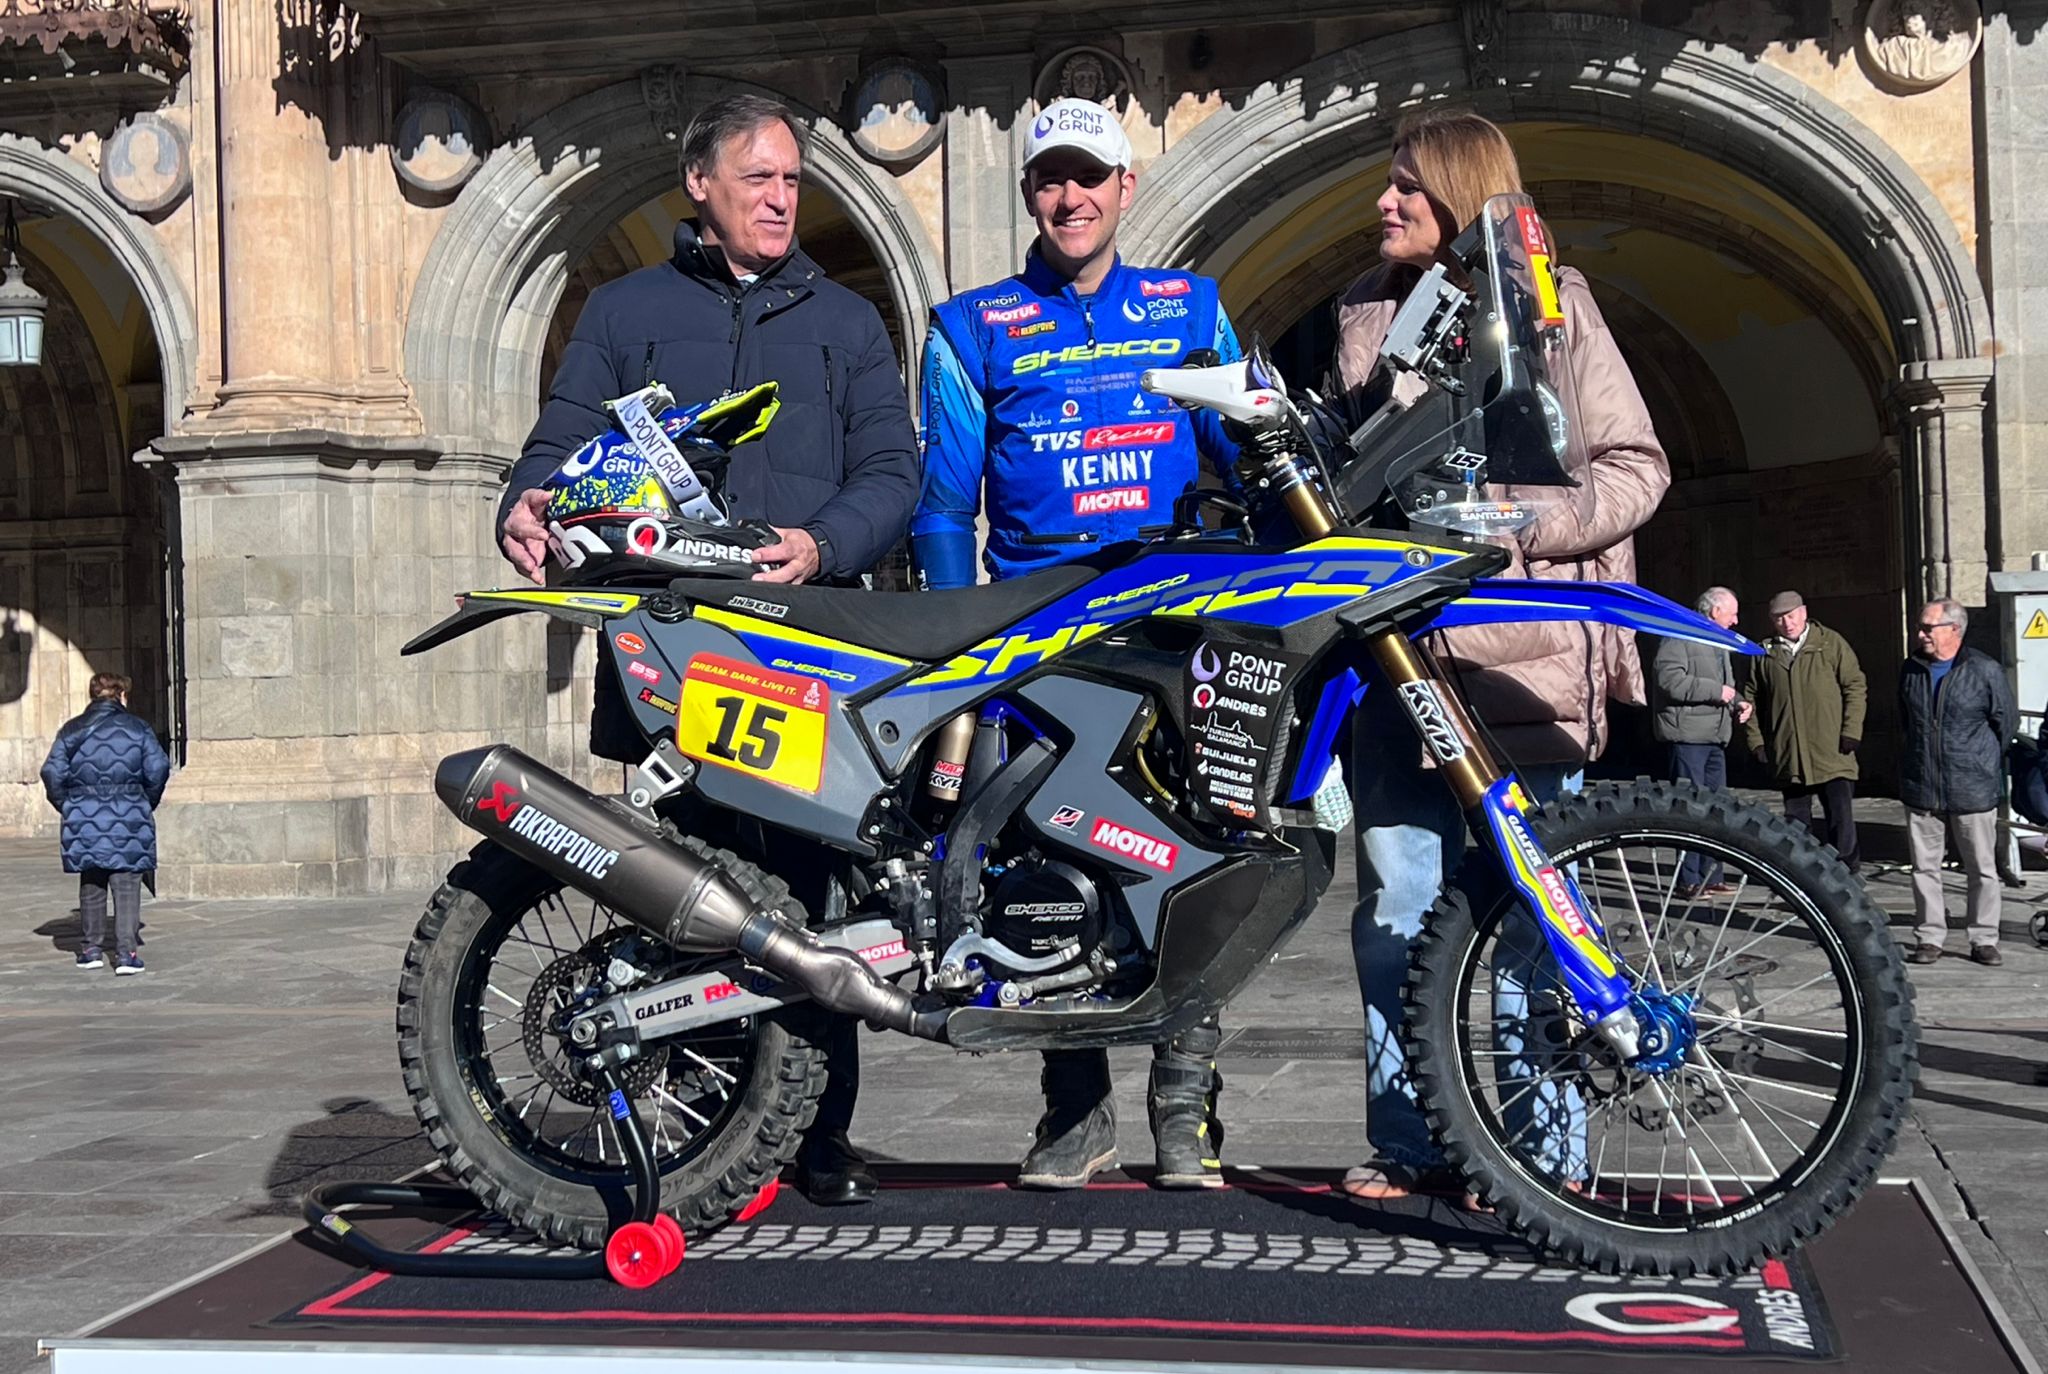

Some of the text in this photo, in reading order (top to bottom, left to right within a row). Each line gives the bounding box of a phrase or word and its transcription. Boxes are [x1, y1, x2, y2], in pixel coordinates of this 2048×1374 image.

[1058, 120, 1104, 136] GRUP
[1059, 108, 1103, 124] PONT
[987, 304, 1038, 322] MOTUL
[1146, 298, 1184, 311] PONT
[1150, 307, 1188, 320] GRUP
[1012, 338, 1181, 375] SHERCO
[1031, 424, 1170, 452] TVS Racing
[630, 415, 667, 456] PONT
[656, 452, 692, 489] GRUP
[1062, 450, 1153, 488] KENNY
[1078, 490, 1145, 512] MOTUL
[1086, 574, 1190, 610] SHERCO
[690, 660, 797, 696] DREAM. DARE. LIVE IT.
[771, 658, 857, 682] SHERCO
[1229, 651, 1287, 679] PONT
[1225, 670, 1282, 696] GRUP
[706, 696, 788, 770] 15
[1202, 746, 1257, 767] GUIJUELO
[1209, 765, 1253, 784] CANDELAS
[1093, 823, 1172, 867] MOTUL
[1508, 815, 1541, 868] GALFER
[1004, 902, 1085, 915] SHERCO
[1541, 872, 1585, 934] MOTUL
[859, 940, 907, 961] MOTUL
[703, 980, 742, 1003] RK
[634, 994, 694, 1020] GALFER
